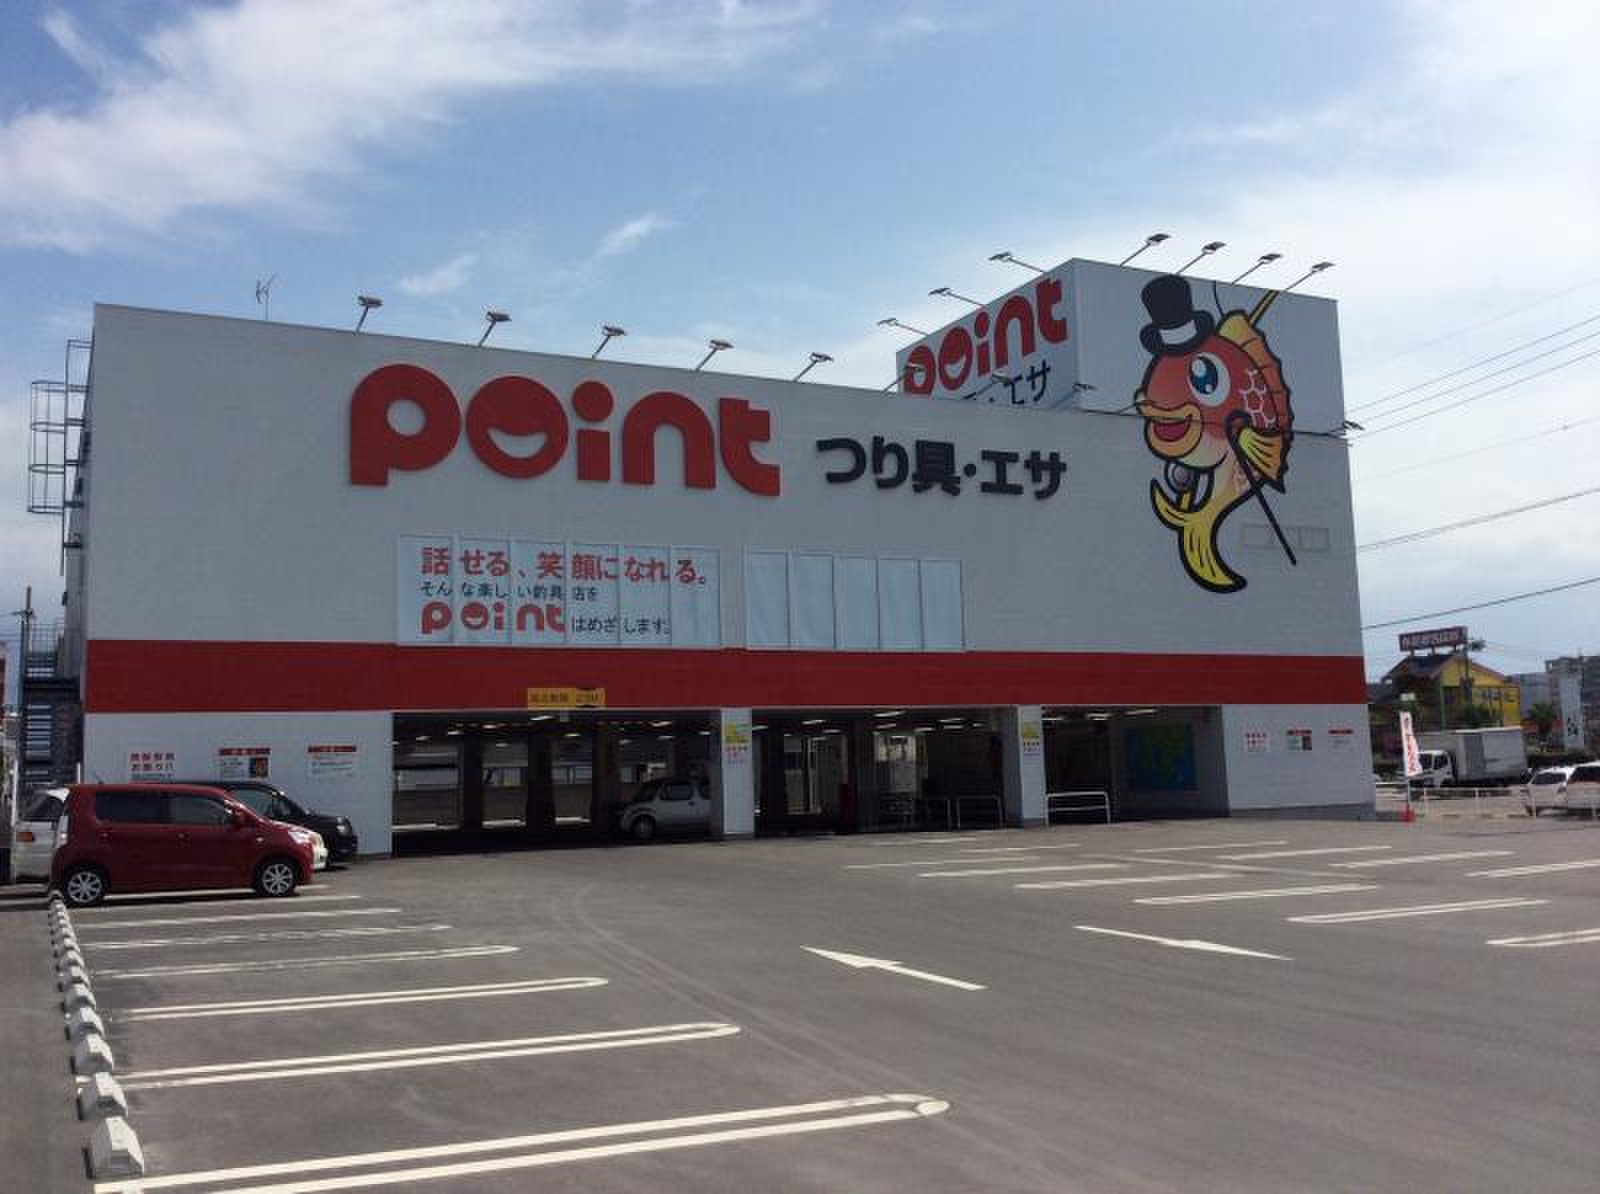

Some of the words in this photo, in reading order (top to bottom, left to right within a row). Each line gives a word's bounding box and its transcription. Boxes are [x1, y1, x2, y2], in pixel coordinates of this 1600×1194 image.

[902, 279, 1068, 396] point
[350, 363, 781, 497] point
[816, 435, 1067, 499] つり具・エサ
[421, 601, 566, 635] point
